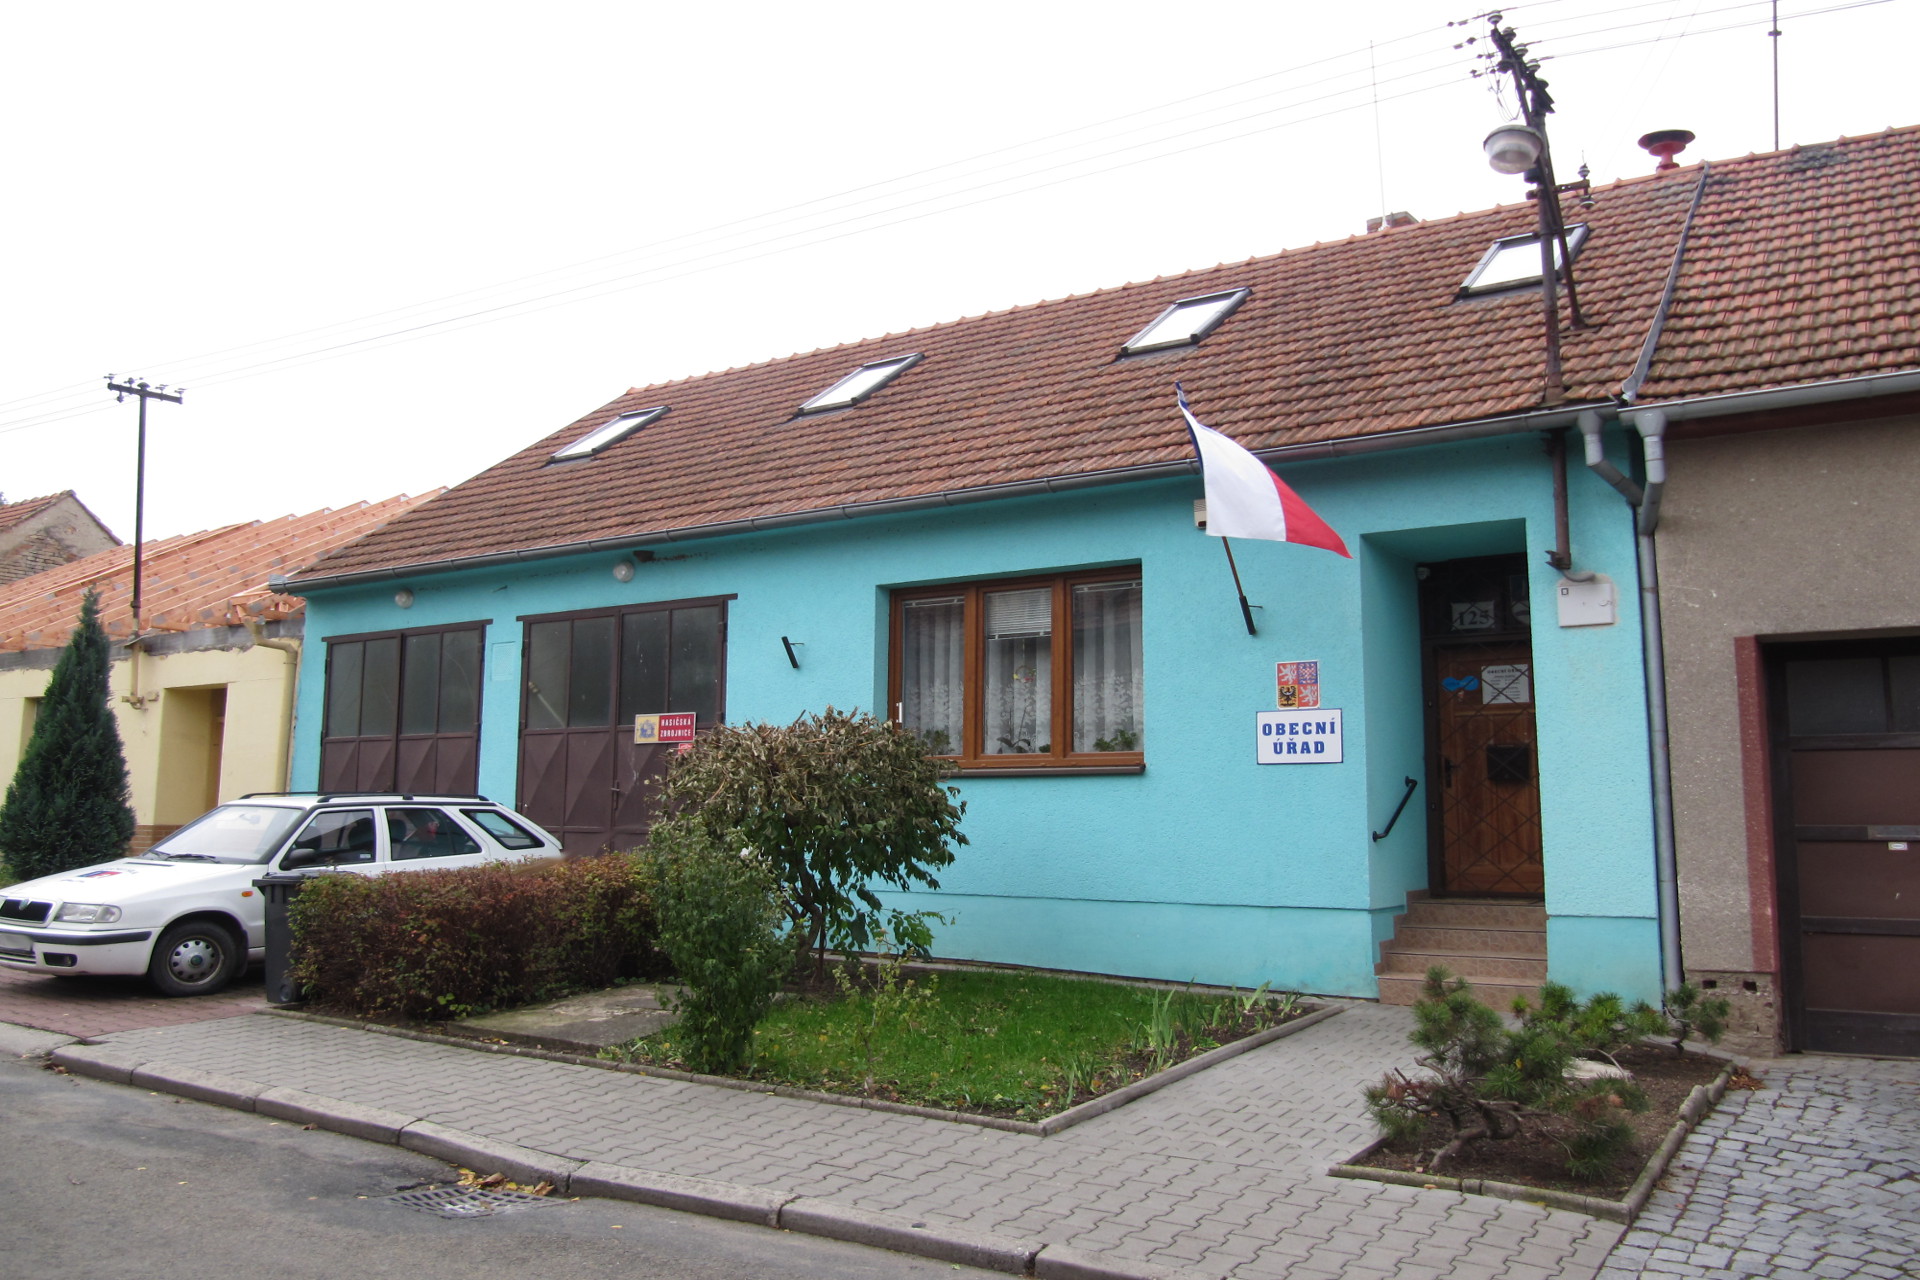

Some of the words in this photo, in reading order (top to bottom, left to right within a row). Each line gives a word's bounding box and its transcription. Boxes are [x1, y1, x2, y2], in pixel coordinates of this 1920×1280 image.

[1459, 609, 1490, 626] 125
[660, 729, 691, 737] ZBROJNICE
[1262, 717, 1336, 736] OBECNÍ
[1272, 737, 1325, 755] ÚŘAD
